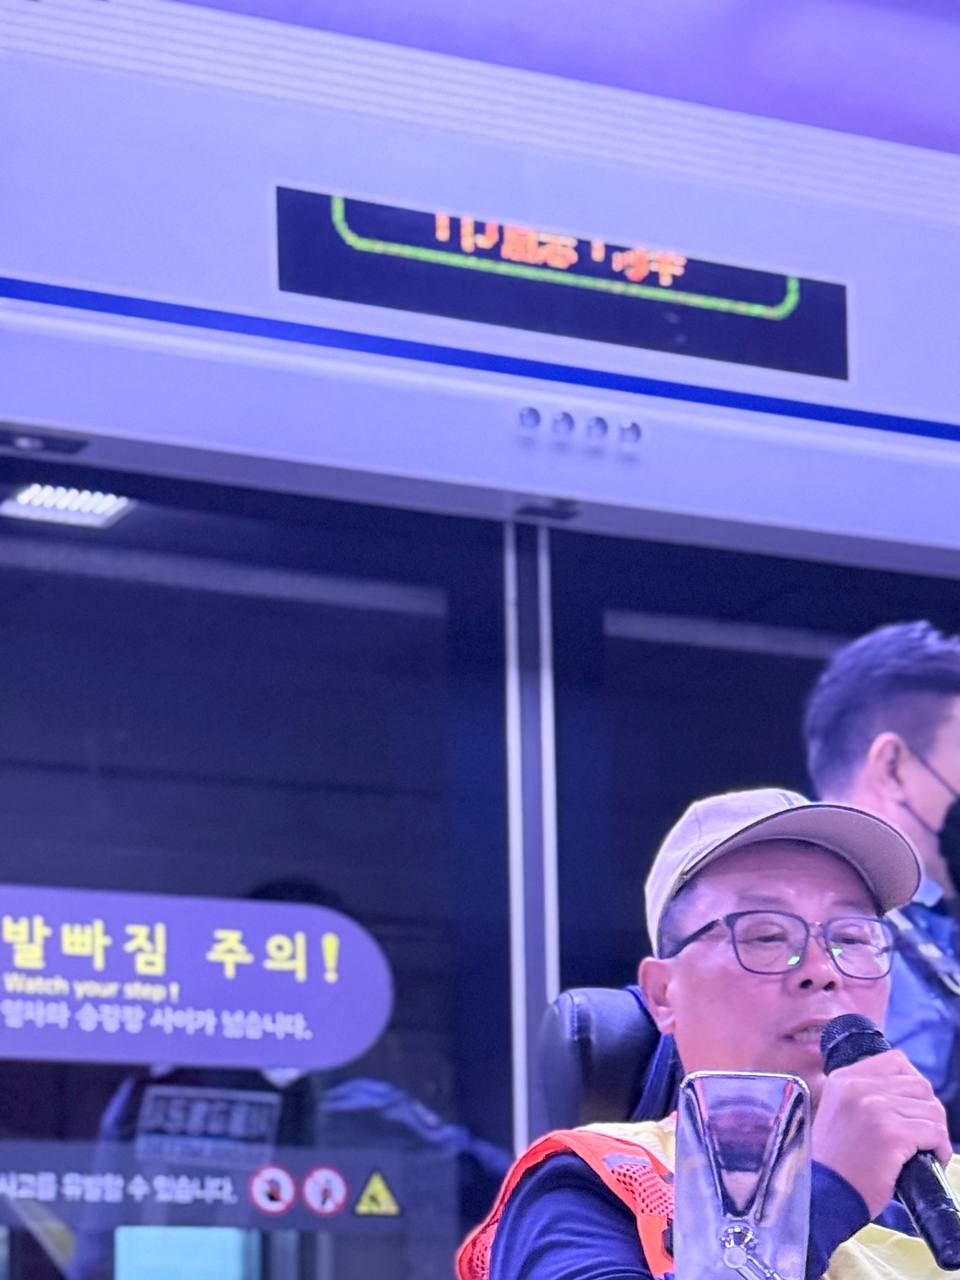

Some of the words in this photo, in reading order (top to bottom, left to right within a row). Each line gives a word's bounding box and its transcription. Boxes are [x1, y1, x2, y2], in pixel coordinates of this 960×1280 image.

[2, 914, 167, 976] 발빠짐
[206, 929, 340, 984] 주의!
[3, 972, 70, 996] Watch
[73, 980, 120, 1000] your
[75, 1002, 146, 1034] 승강장
[150, 1006, 216, 1036] 사이가
[127, 1173, 149, 1202] 수
